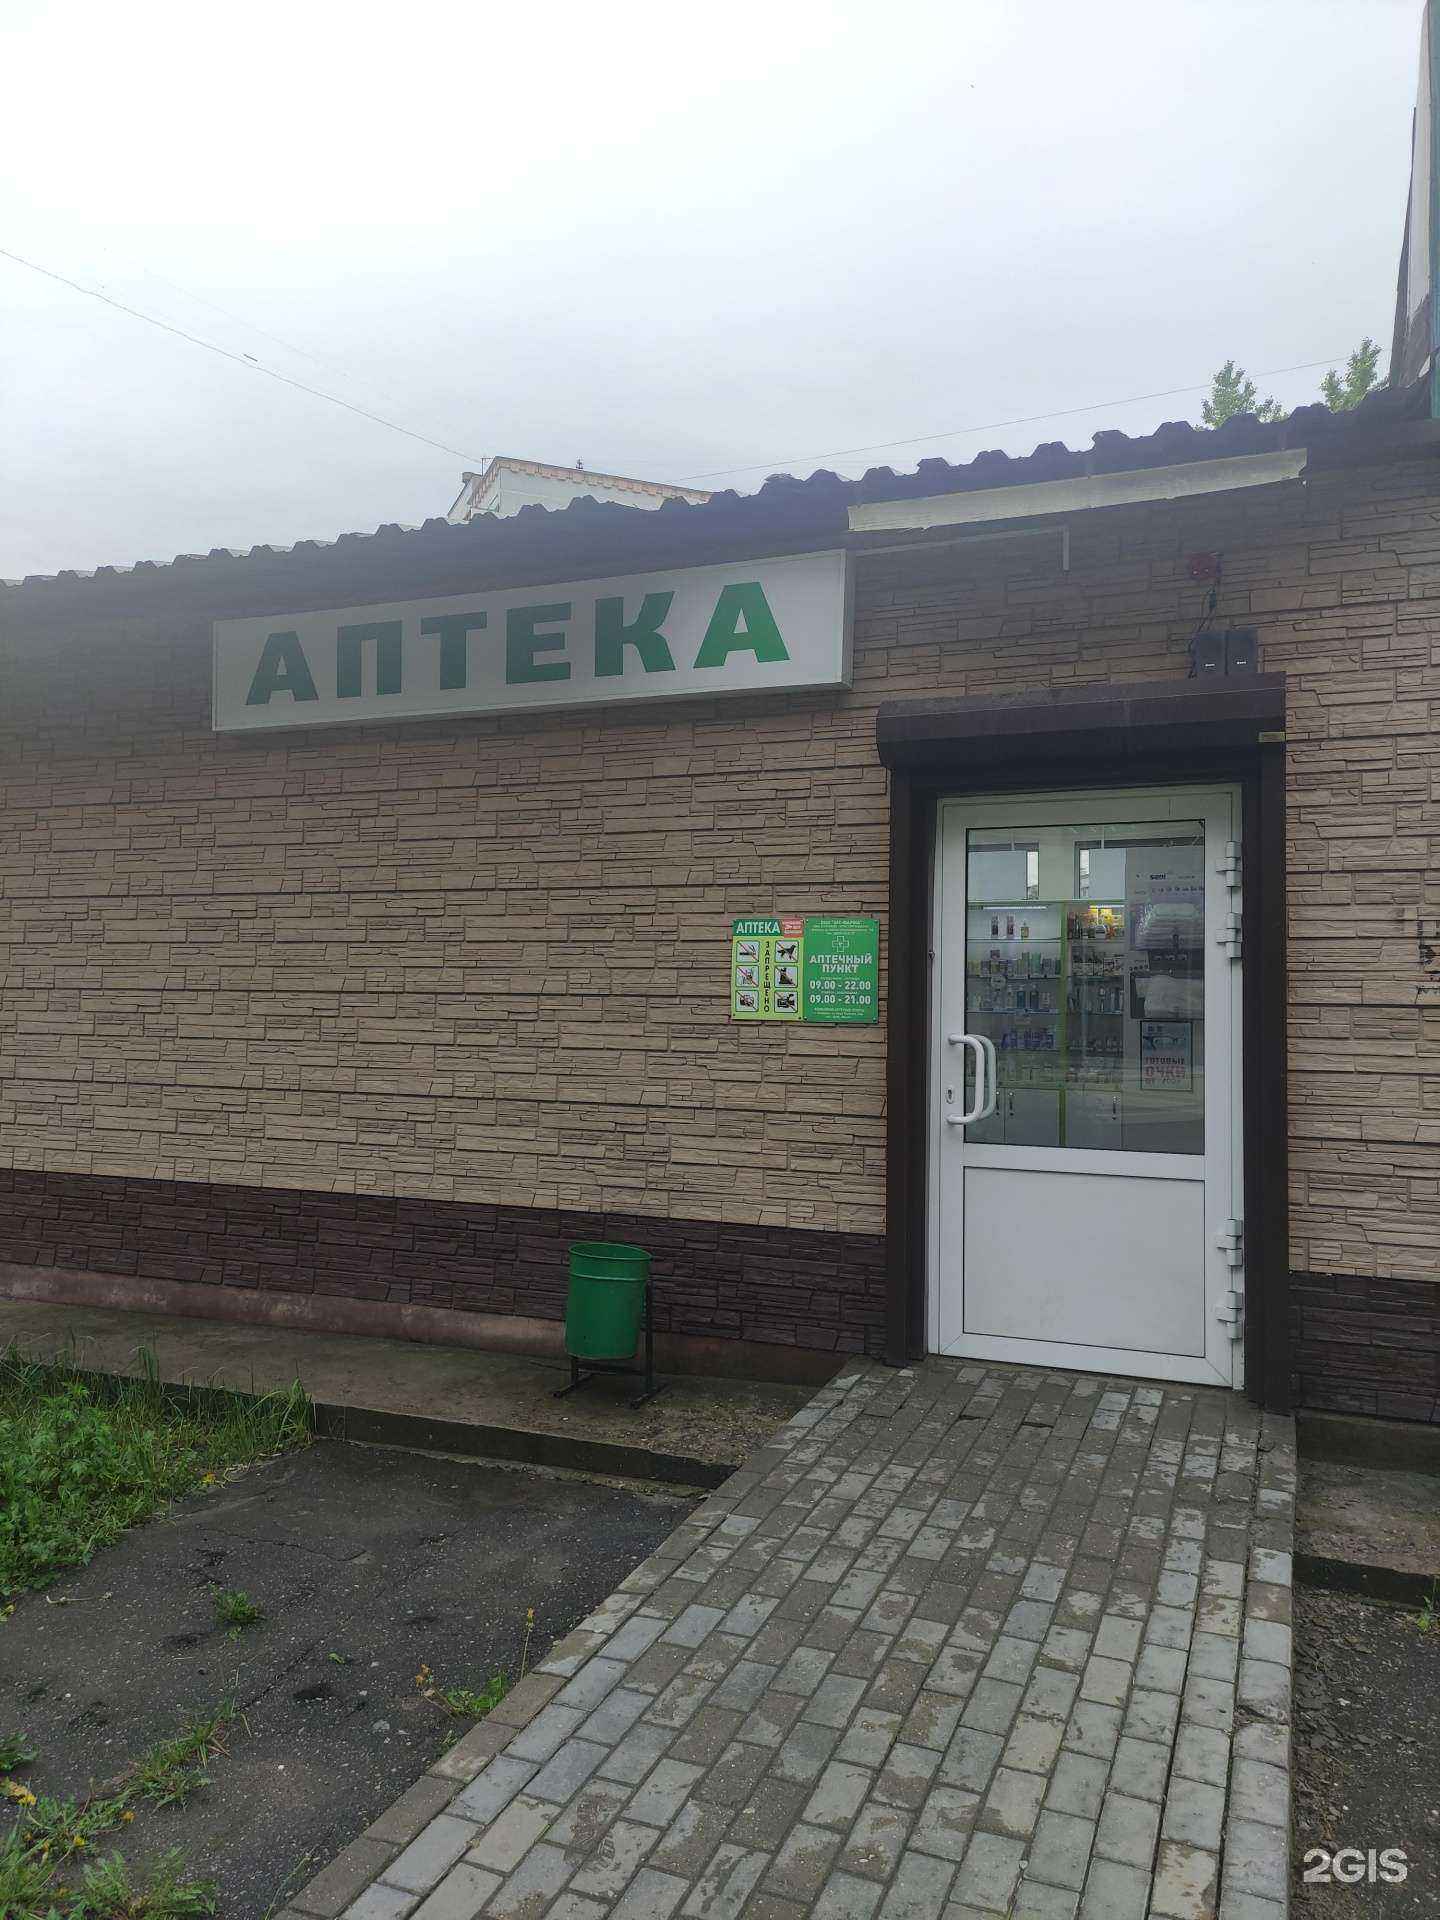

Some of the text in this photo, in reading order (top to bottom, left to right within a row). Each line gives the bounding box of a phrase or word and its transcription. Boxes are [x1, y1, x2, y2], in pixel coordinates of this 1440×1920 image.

[246, 581, 791, 706] АПТЕКА
[736, 922, 781, 934] АПТЕКА
[809, 953, 873, 964] АПТЕЧНЫЙ
[821, 964, 859, 973] ПУНКТ
[763, 941, 771, 1013] ЗАПРЕЩЕНО
[809, 981, 836, 990] 09.00
[844, 981, 871, 990] 22.00
[809, 994, 836, 1003] 09.00
[844, 995, 871, 1004] 21.00
